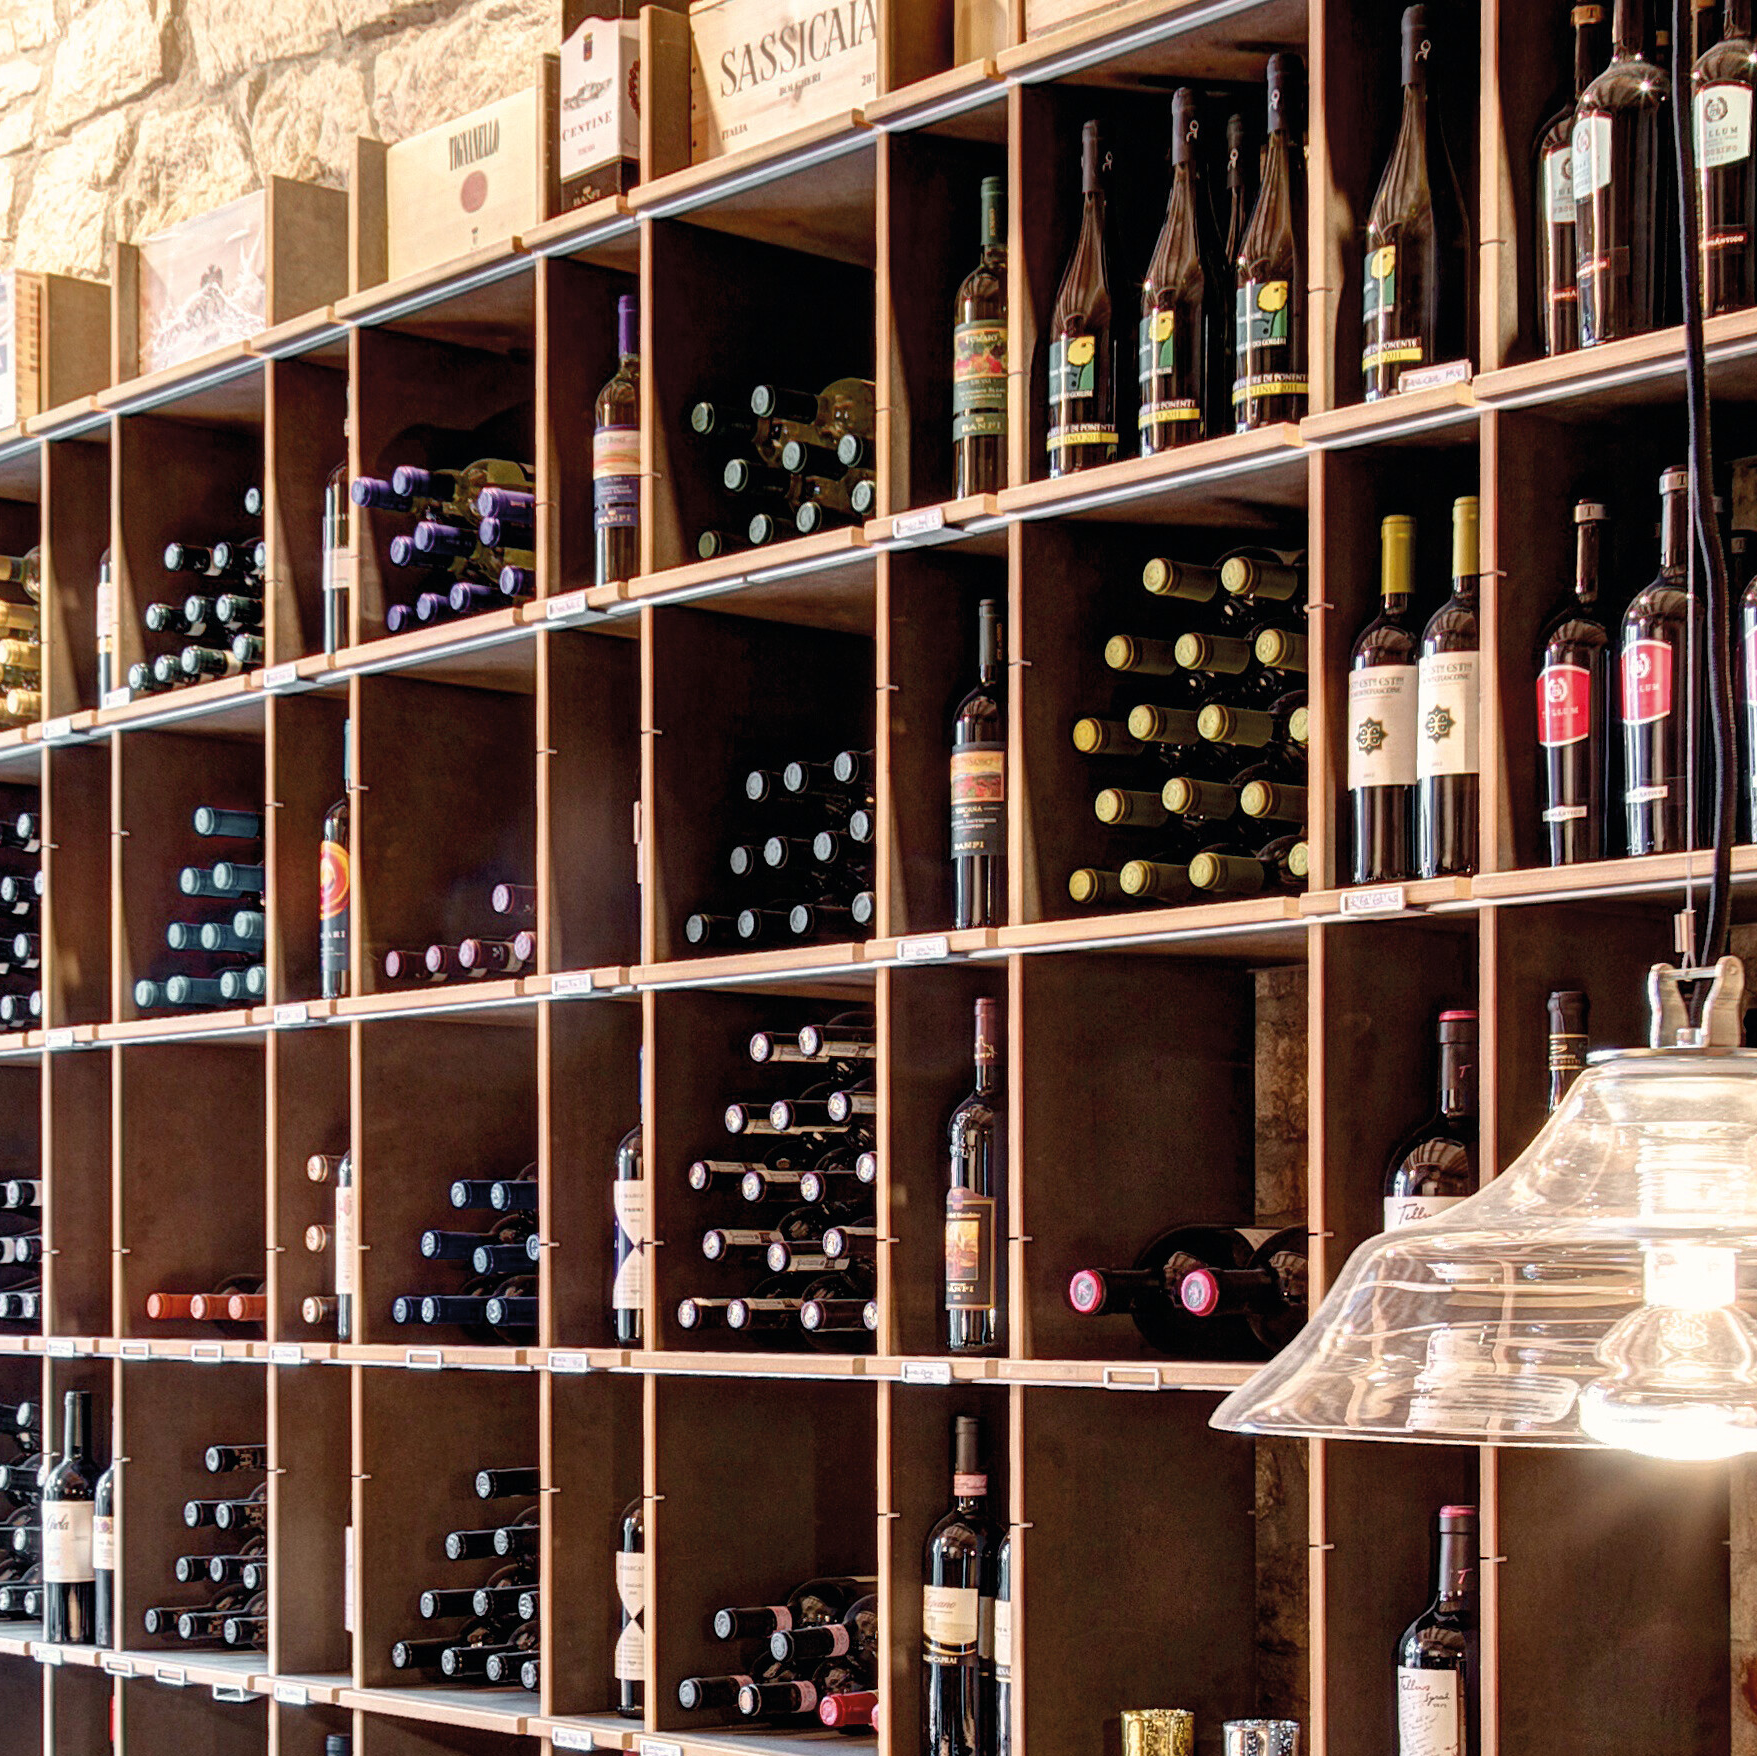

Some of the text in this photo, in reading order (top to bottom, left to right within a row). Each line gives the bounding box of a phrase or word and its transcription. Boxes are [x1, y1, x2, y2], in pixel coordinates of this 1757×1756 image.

[719, 0, 878, 99] SASSICAIA
[561, 110, 614, 143] CENTINE
[721, 124, 748, 142] ITALIA
